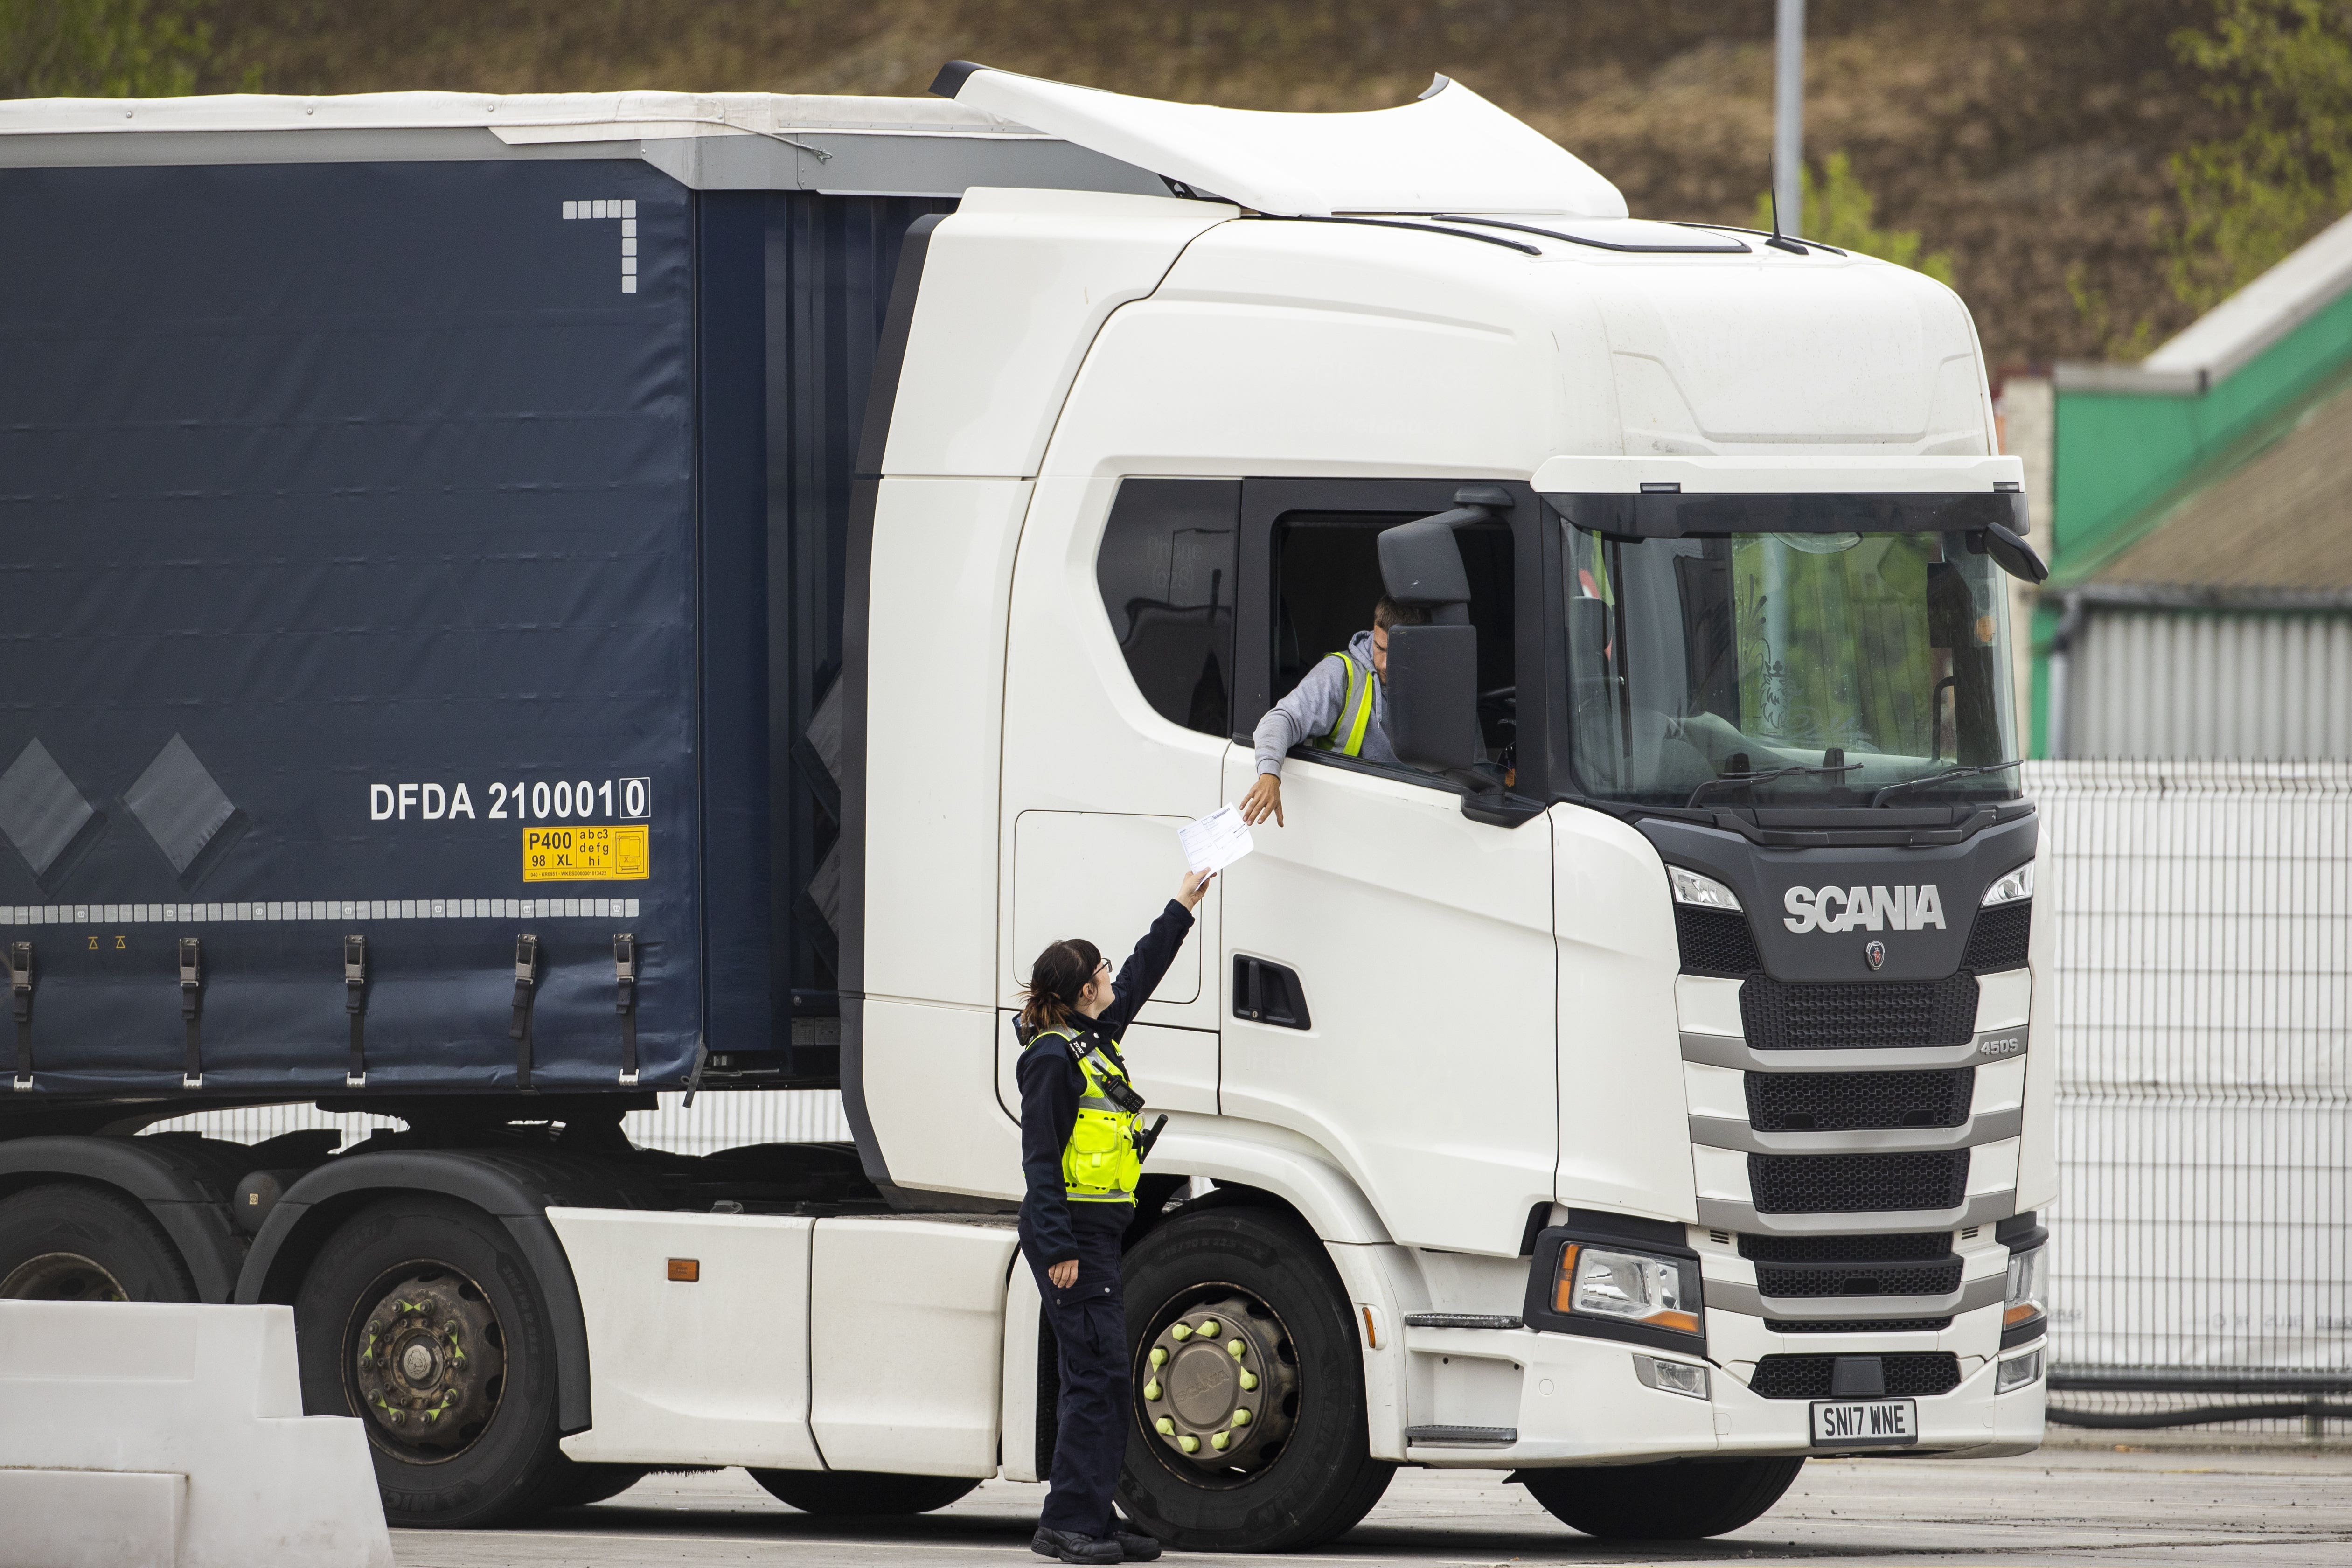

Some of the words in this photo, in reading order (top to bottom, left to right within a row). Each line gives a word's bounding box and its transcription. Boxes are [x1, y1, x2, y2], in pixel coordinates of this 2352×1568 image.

[371, 783, 475, 820] DFDA
[529, 832, 571, 850] P400
[532, 855, 546, 867] 98
[557, 854, 573, 866] XL
[1783, 885, 1947, 934] SCANIA
[1073, 1041, 1085, 1053] 20157
[1980, 1038, 2018, 1055] 450S
[1177, 1370, 1230, 1402] SCANIA
[1824, 1407, 1864, 1436] SN17
[1870, 1405, 1906, 1434] WNE
